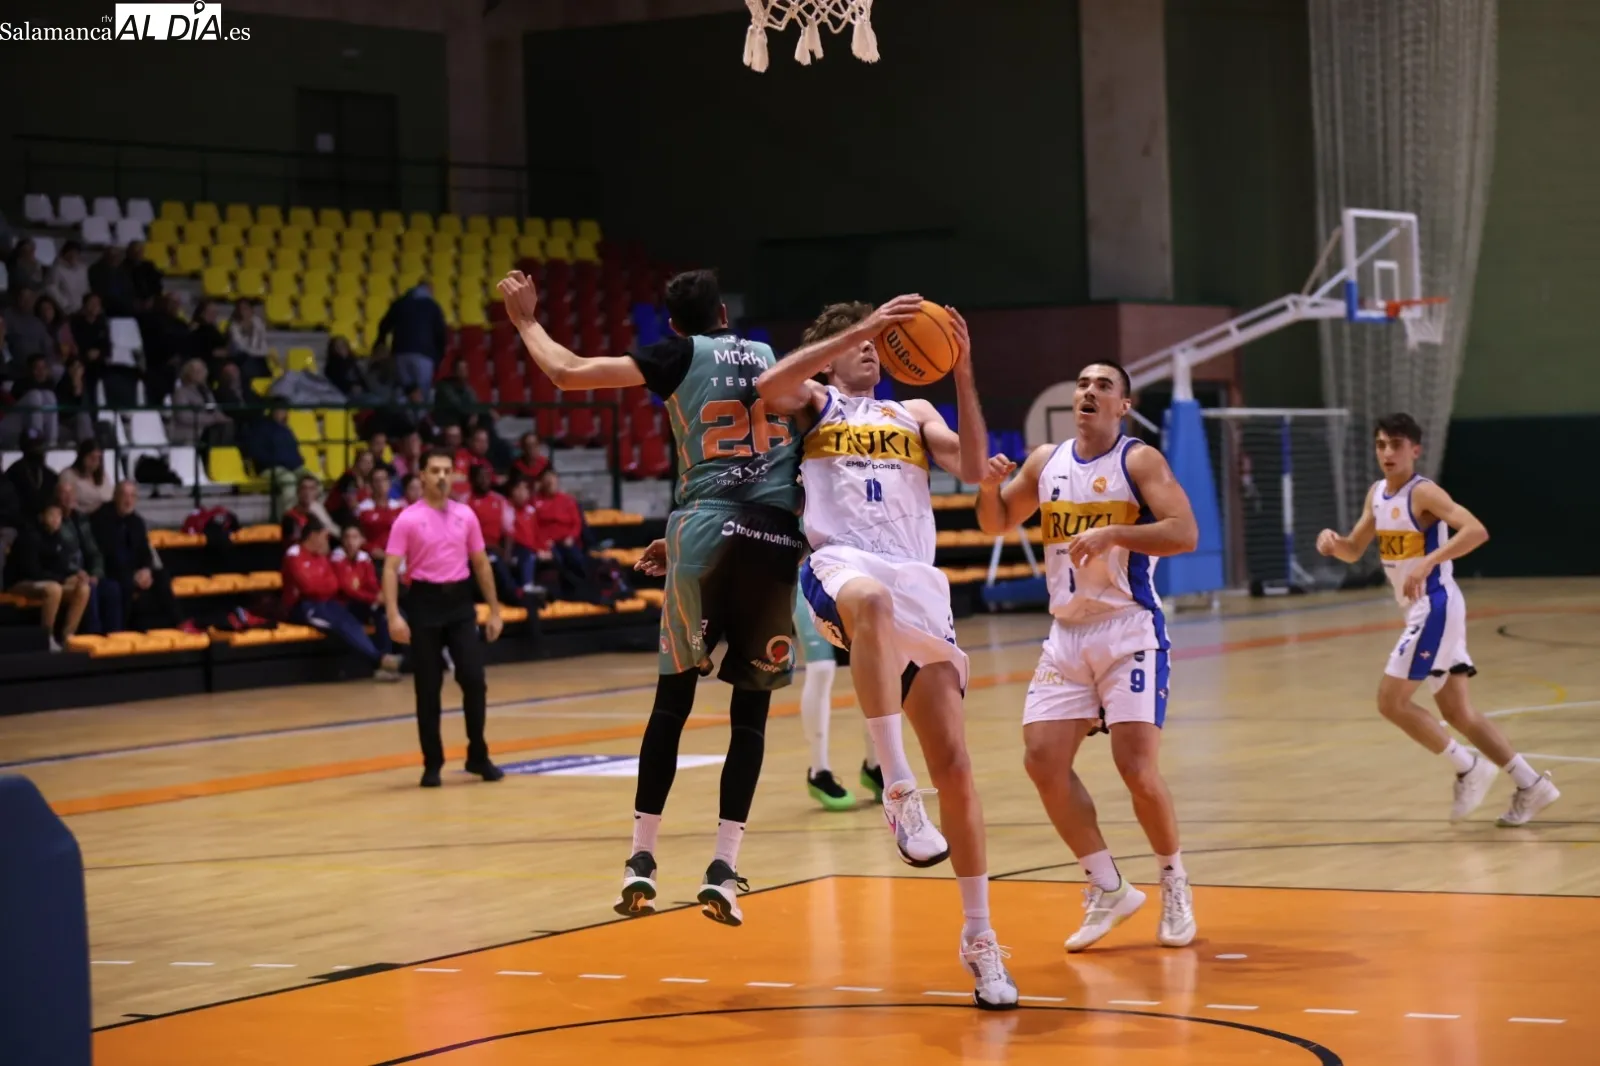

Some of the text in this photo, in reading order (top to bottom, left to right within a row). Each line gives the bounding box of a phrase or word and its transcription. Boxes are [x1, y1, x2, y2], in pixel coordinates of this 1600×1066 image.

[886, 329, 926, 378] Wilson
[701, 400, 793, 460] 26
[763, 532, 803, 549] nutrition
[1130, 669, 1146, 693] 9
